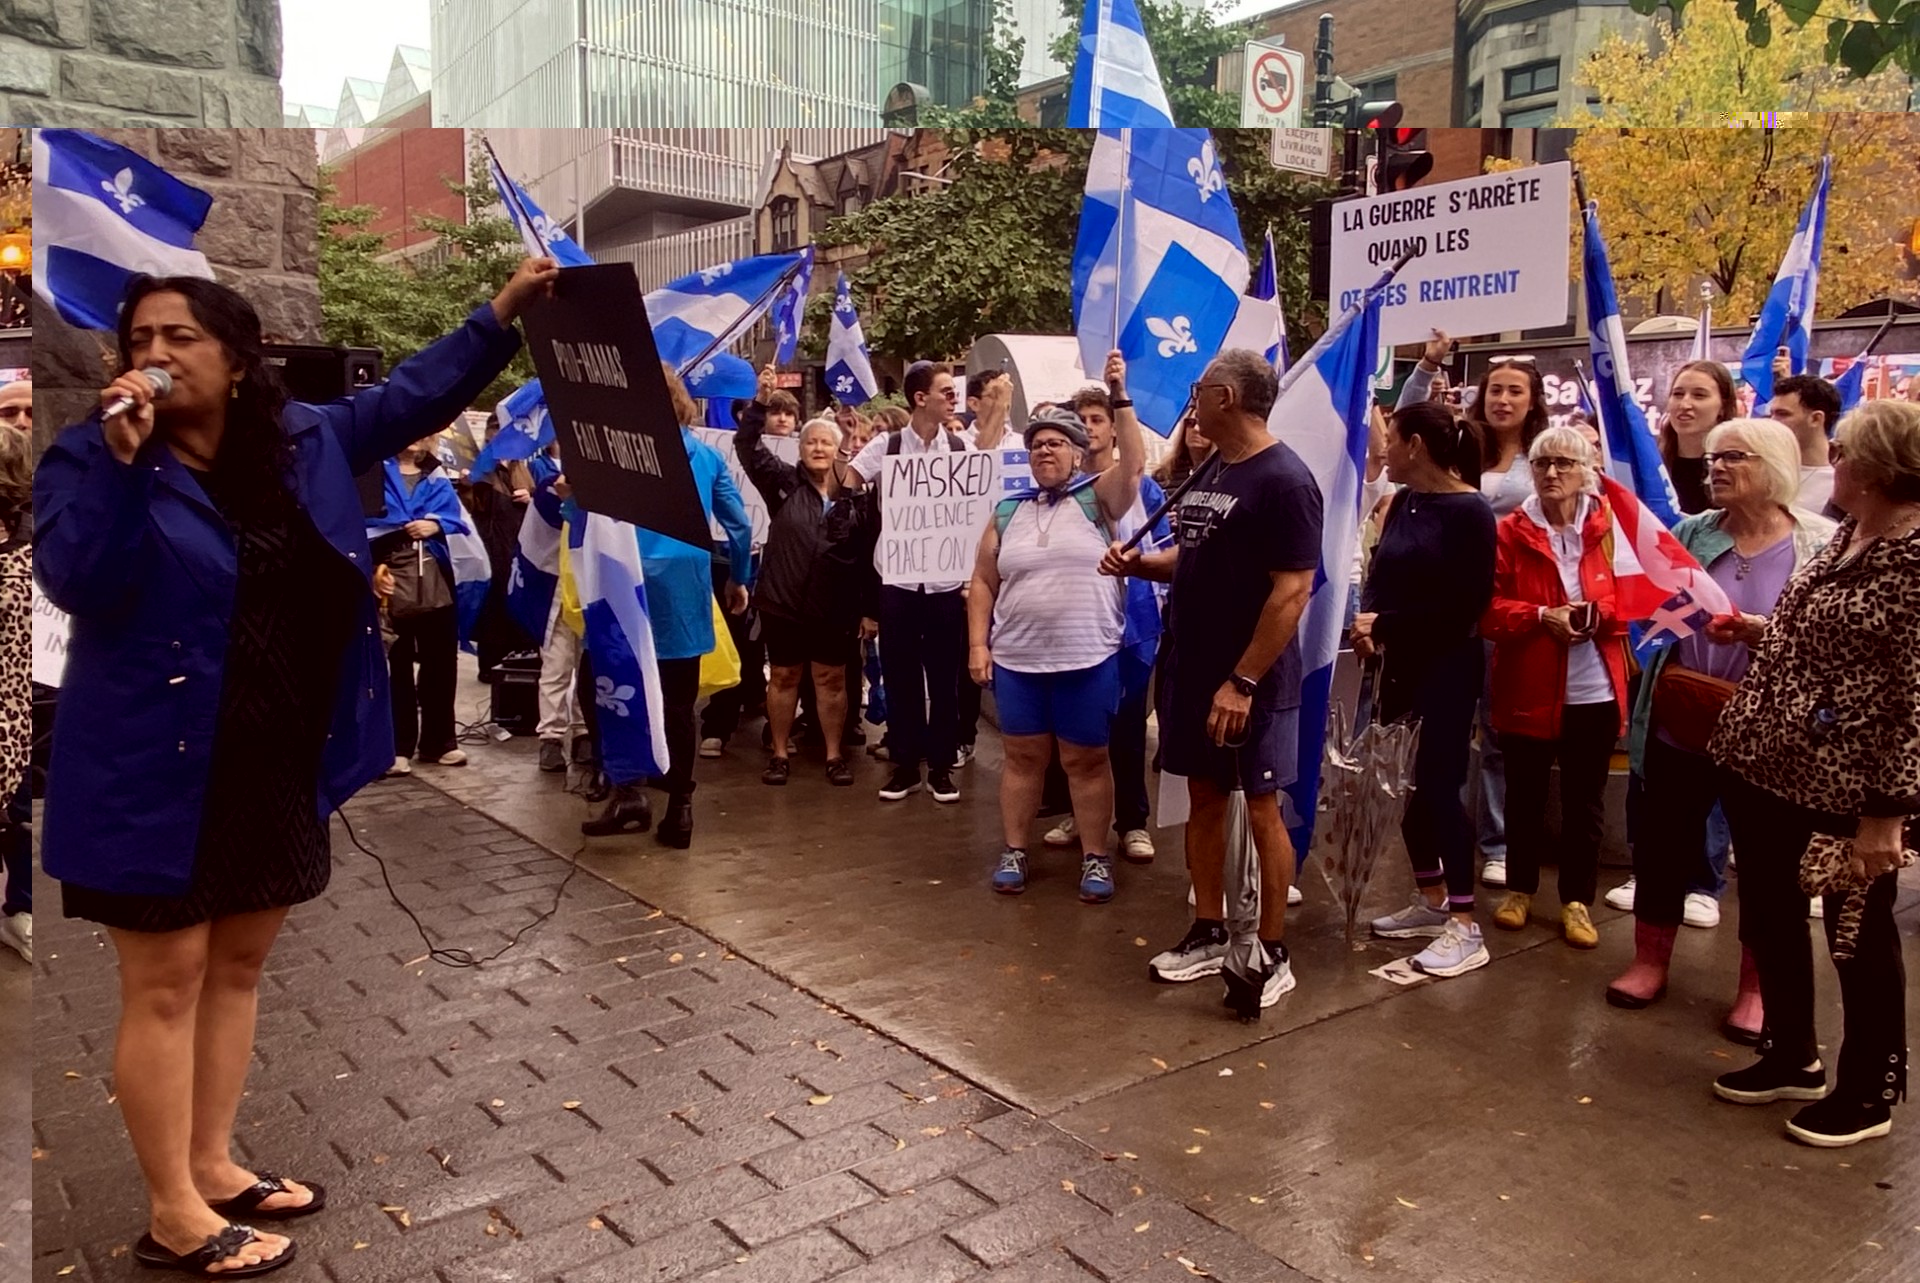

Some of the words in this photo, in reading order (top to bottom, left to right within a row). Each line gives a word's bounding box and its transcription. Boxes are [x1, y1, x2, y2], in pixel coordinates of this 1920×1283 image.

[1280, 140, 1322, 156] LIVRAISON
[1286, 154, 1316, 168] LOCALE
[1343, 209, 1364, 232] LA
[1369, 196, 1436, 226] GUERRE
[1368, 236, 1427, 266] QUAND
[1436, 228, 1470, 254] LES
[1420, 270, 1520, 302] RENTRENT
[551, 339, 628, 389] PRO-HAMAS
[572, 420, 604, 462] FAIT
[603, 425, 663, 478] FORTFAIT
[889, 453, 992, 498] MASKED
[889, 500, 977, 532] VIOLENCE
[887, 537, 932, 575] PLACE
[938, 537, 967, 572] ON
